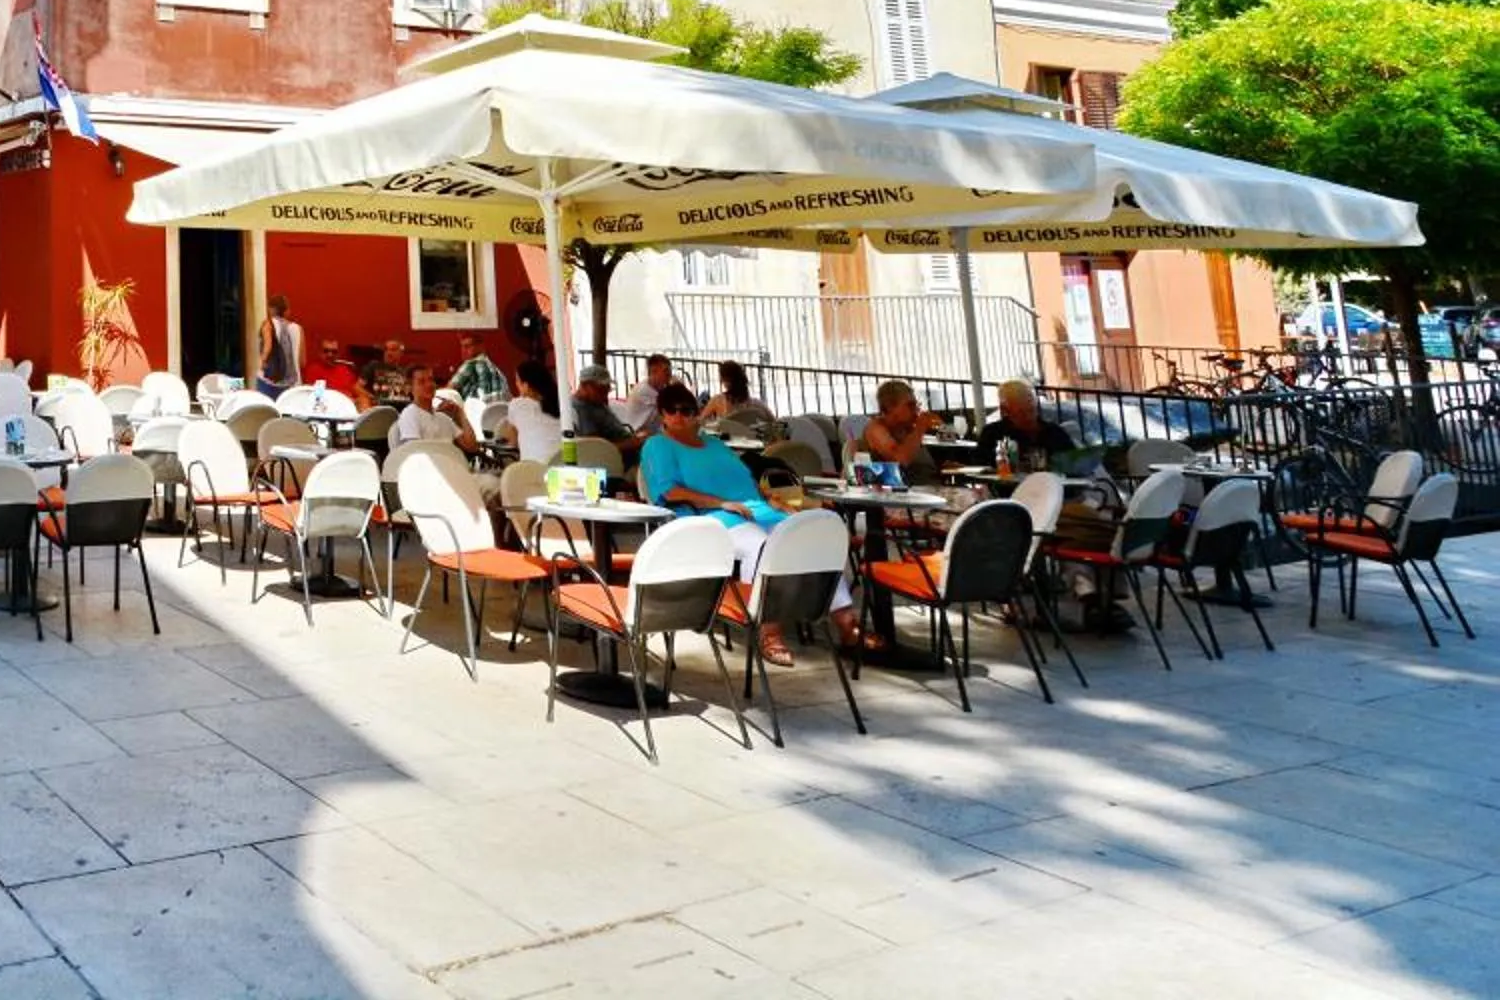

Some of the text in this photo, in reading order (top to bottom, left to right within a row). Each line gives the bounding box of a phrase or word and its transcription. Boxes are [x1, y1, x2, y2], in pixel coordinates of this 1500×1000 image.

[271, 204, 474, 230] DELICIOUS AND REFRESHING
[678, 184, 915, 225] DELICIOUS AND REFRESHING
[983, 224, 1237, 243] DELICIOUS AND REFRESHING
